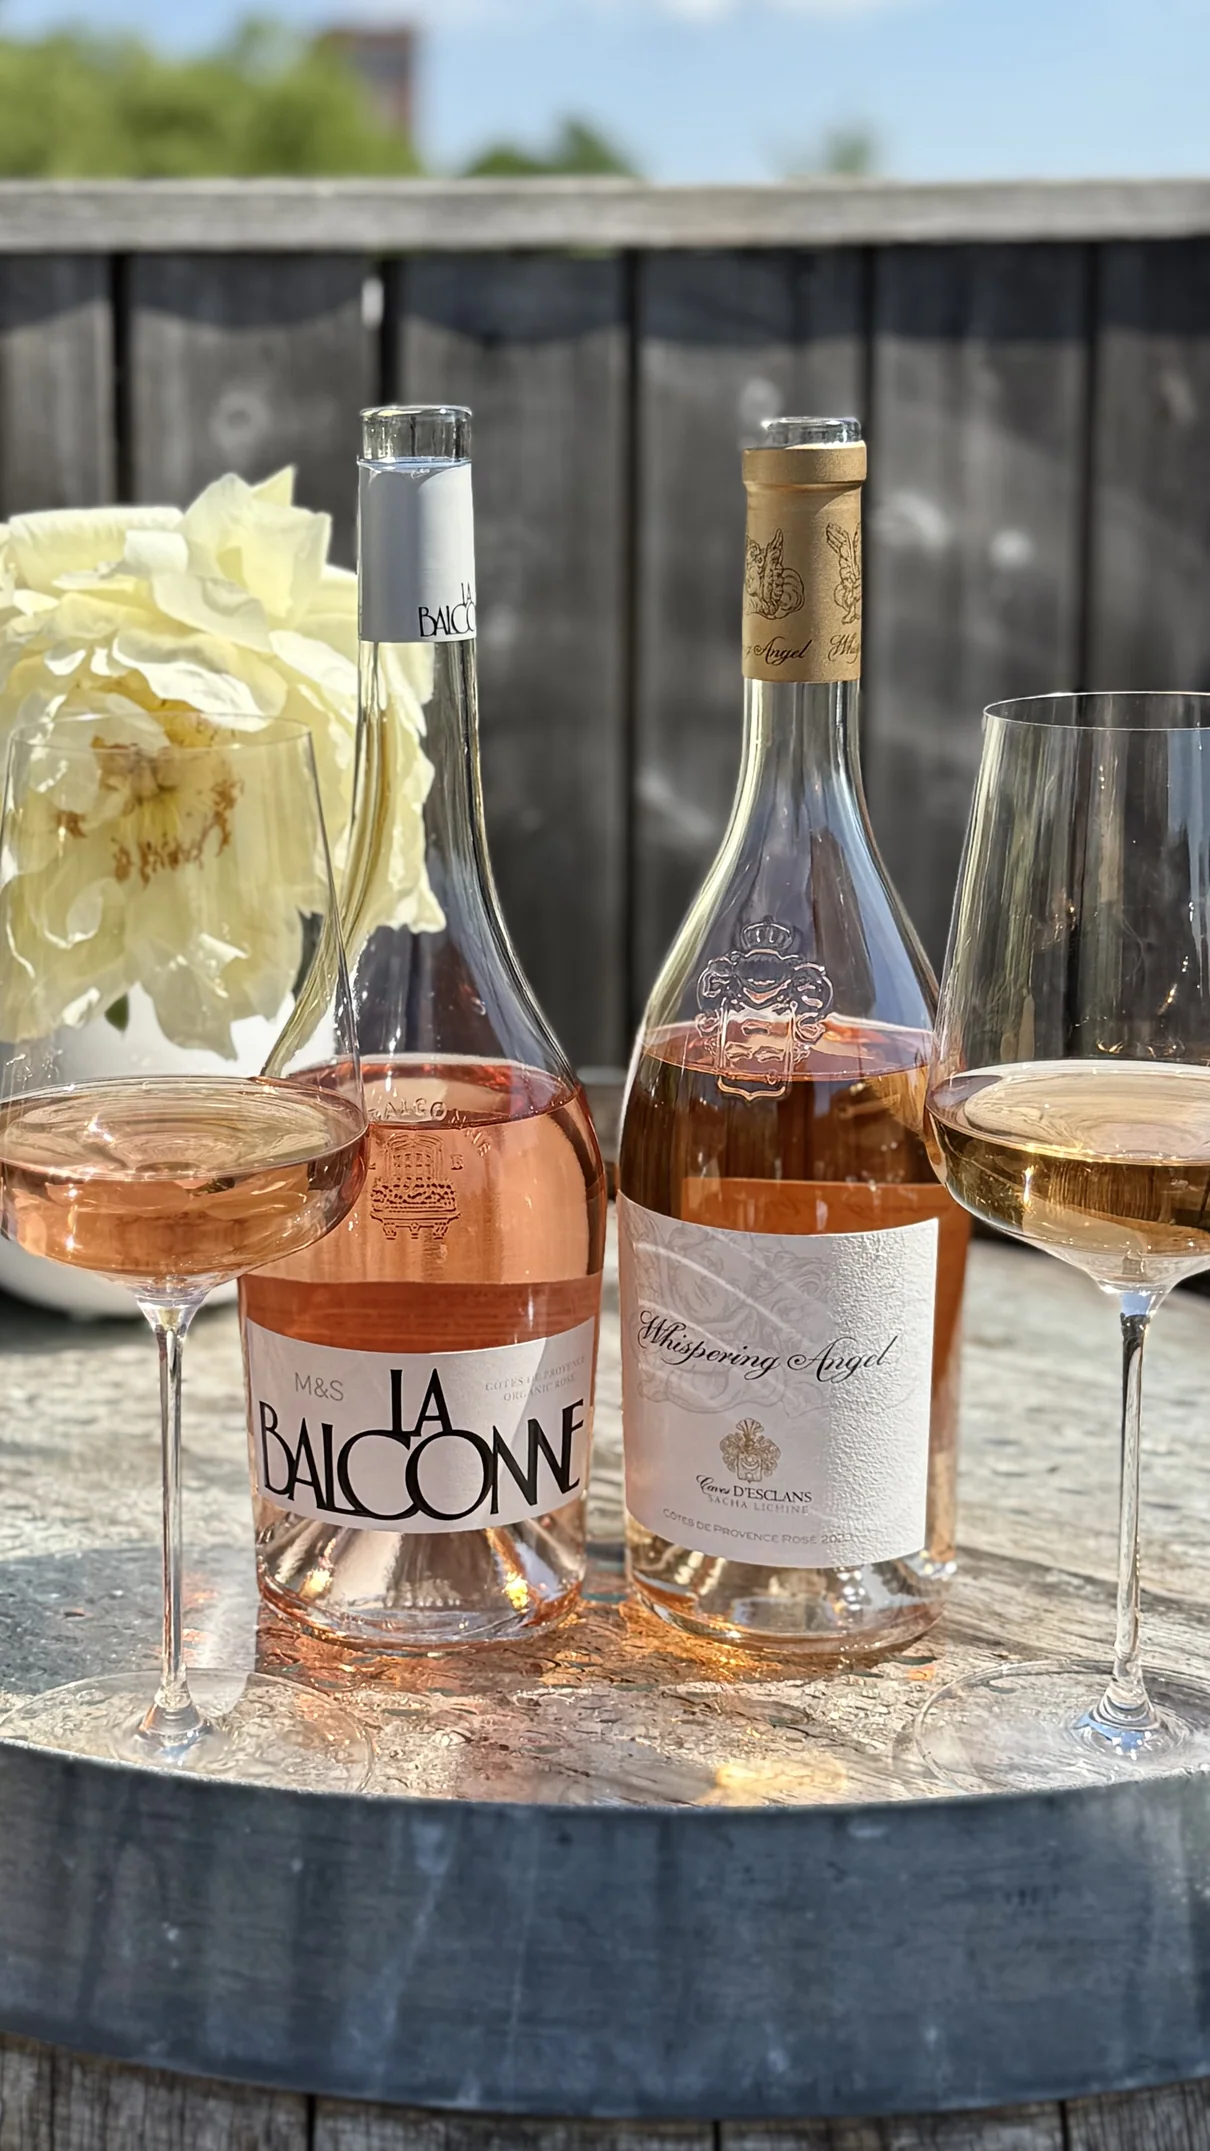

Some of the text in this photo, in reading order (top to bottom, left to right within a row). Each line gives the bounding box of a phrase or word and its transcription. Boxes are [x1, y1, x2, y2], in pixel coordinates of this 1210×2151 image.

[753, 635, 812, 666] Angel
[638, 1310, 898, 1384] Whispering Angel
[295, 1371, 344, 1401] M&S
[390, 1367, 453, 1437] LA
[259, 1398, 584, 1521] BALCONNE
[708, 1494, 809, 1515] SACHA LICHINE
[733, 1485, 813, 1503] D'ESCLANS
[696, 1520, 712, 1532] DE
[713, 1524, 779, 1543] PROVENCE
